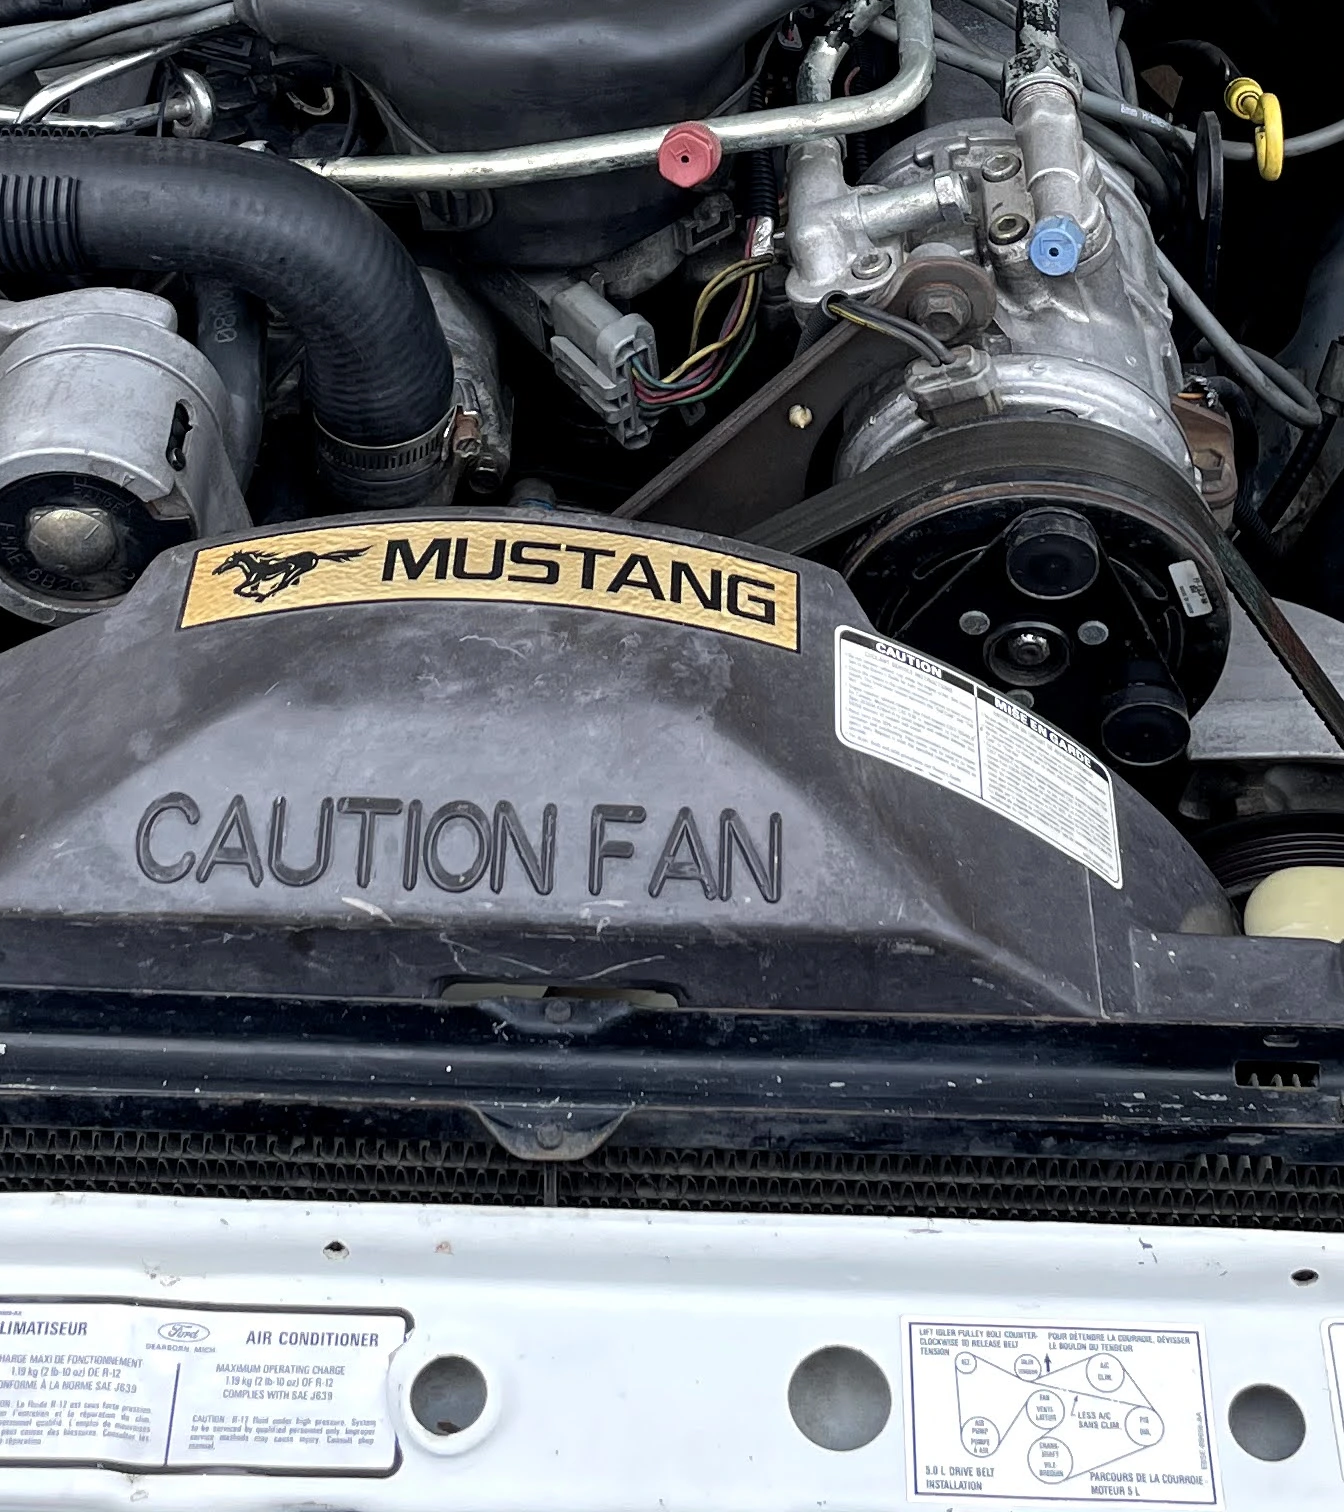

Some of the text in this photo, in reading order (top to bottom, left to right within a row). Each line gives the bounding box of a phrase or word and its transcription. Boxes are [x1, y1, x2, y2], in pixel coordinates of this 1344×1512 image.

[381, 537, 776, 626] MUSTANG
[876, 643, 942, 679] CAUTION
[994, 698, 1093, 768] MISE EN GARDE
[135, 793, 783, 902] CAUTION FAN
[168, 1323, 199, 1340] Ford
[246, 1331, 379, 1347] AIR CONDITIONER
[30, 1354, 52, 1364] MAXI
[55, 1355, 65, 1364] DE
[67, 1355, 143, 1368] FONCTIONNEMENT
[27, 1367, 38, 1378] kg
[40, 1367, 49, 1377] (2
[73, 1367, 85, 1378] oz)
[88, 1368, 100, 1377] DE
[103, 1368, 121, 1378] R-12
[216, 1363, 345, 1375] MAXIMUM OPERATING CHARGE
[48, 1381, 59, 1390] LA
[62, 1381, 93, 1390] NORME
[95, 1381, 112, 1391] SAE
[114, 1382, 137, 1394] J639
[241, 1376, 252, 1387] kg
[254, 1377, 263, 1387] (2
[287, 1377, 300, 1388] oz)
[302, 1378, 313, 1387] OF
[316, 1378, 334, 1387] R-12
[223, 1389, 333, 1401] COMPLIES WITH SAE J639
[1078, 1411, 1111, 1420] LESS A/C
[1079, 1421, 1099, 1429] SANS
[926, 1465, 994, 1477] 5.0 L DRIVE BELT
[1090, 1472, 1134, 1483] PARCOURS
[1137, 1473, 1147, 1482] DE
[1150, 1473, 1160, 1483] LA
[926, 1479, 982, 1490] INSTALLATION
[1091, 1486, 1126, 1495] MOTEUR
[1135, 1486, 1140, 1496] L
